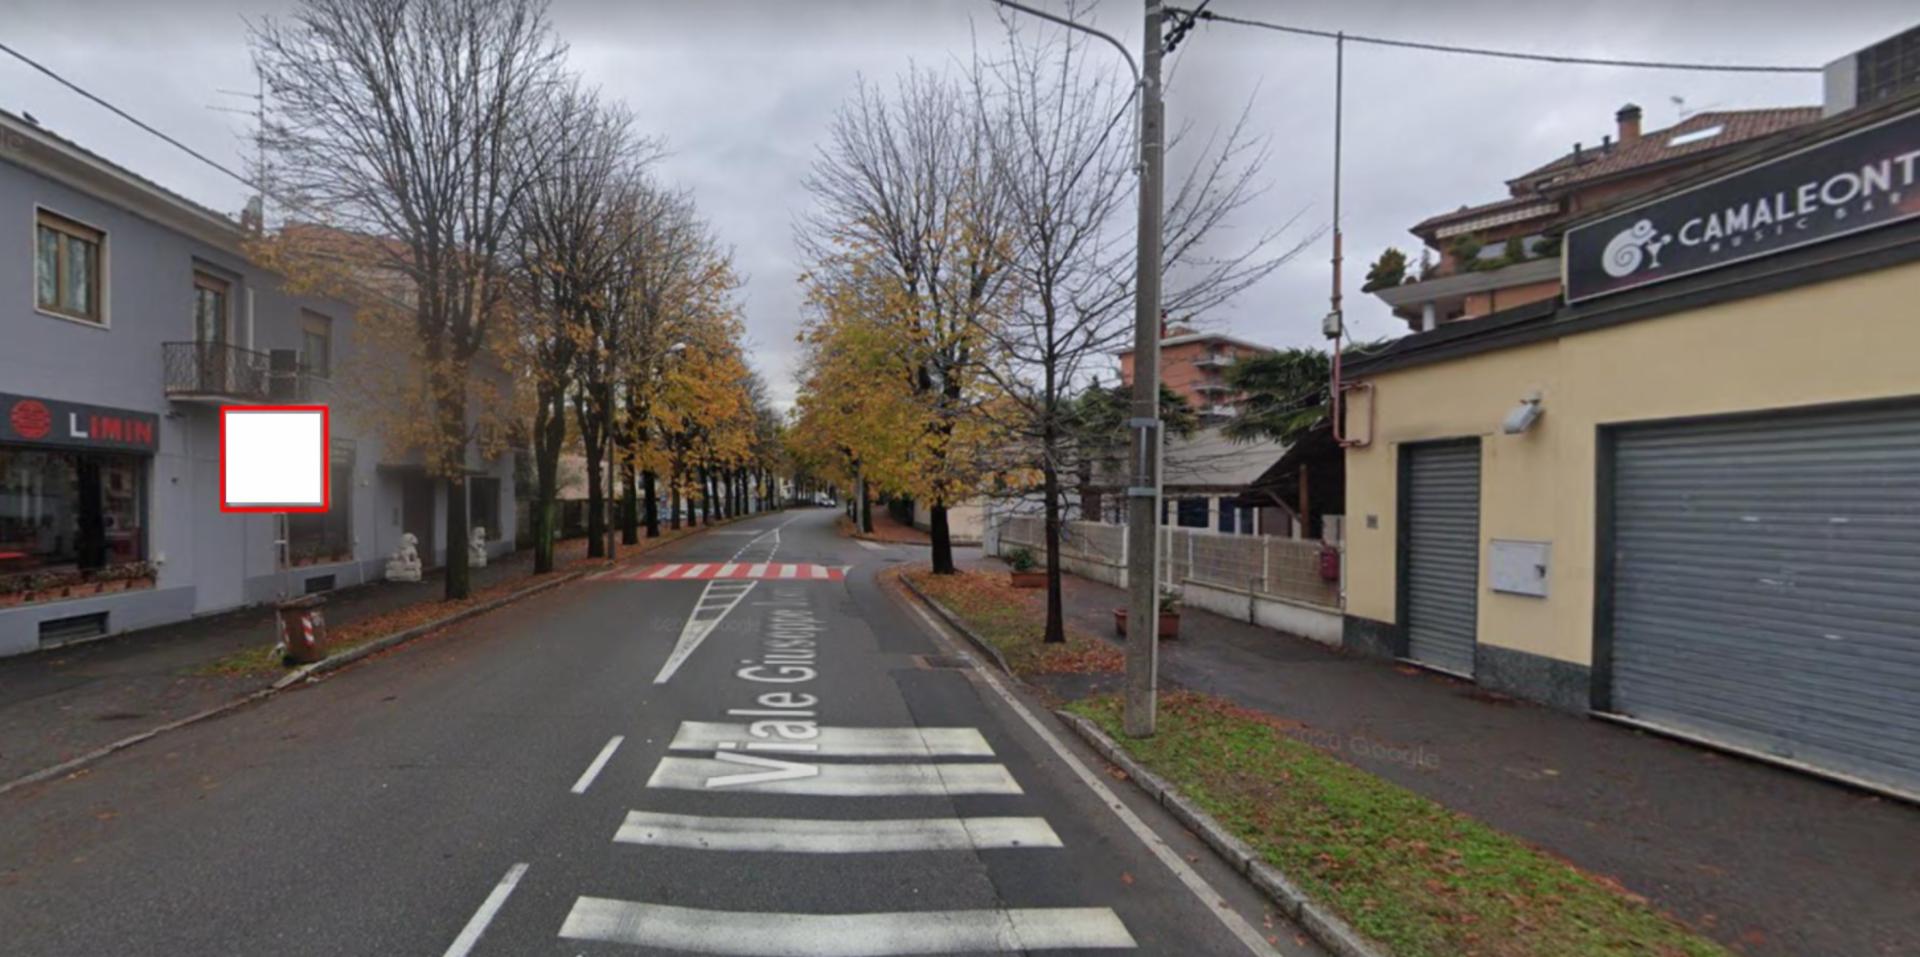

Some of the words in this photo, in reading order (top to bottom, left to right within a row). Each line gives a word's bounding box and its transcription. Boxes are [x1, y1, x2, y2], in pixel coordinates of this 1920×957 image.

[1679, 150, 1920, 247] CAMALEONT
[1710, 217, 1809, 253] MUSIC
[69, 412, 154, 445] LIMIN
